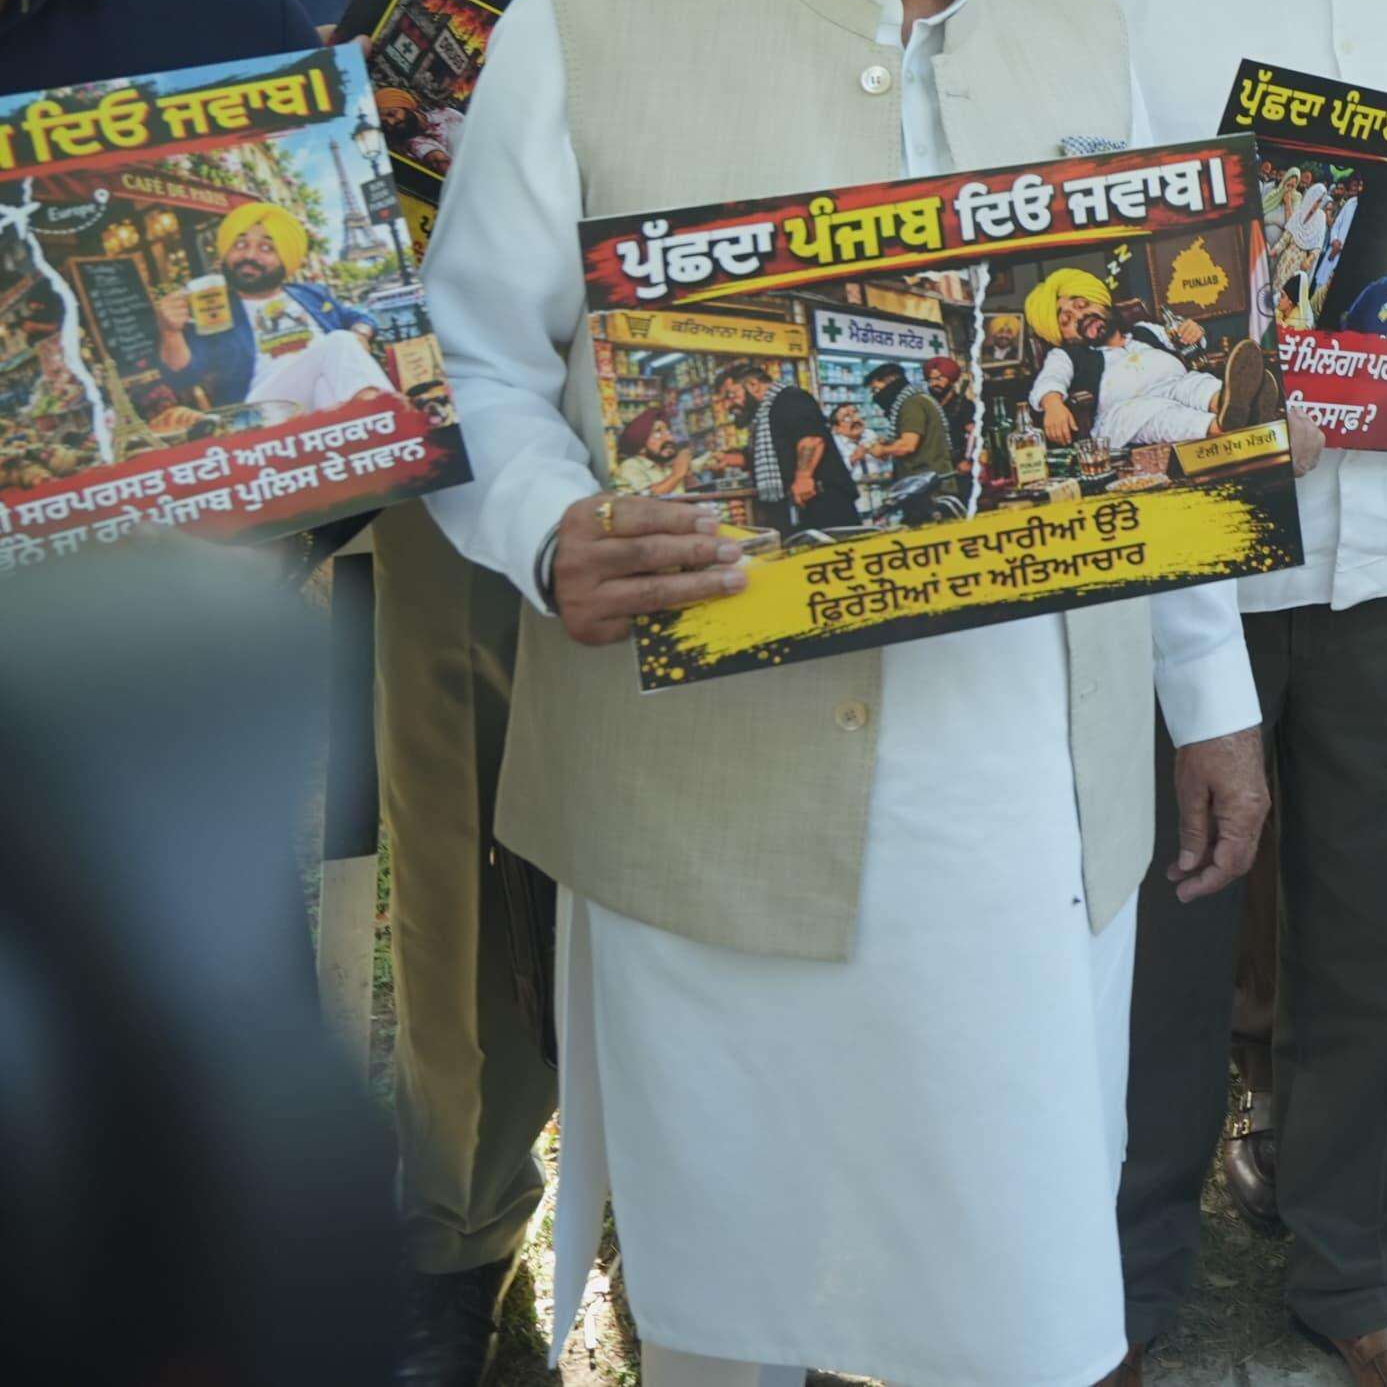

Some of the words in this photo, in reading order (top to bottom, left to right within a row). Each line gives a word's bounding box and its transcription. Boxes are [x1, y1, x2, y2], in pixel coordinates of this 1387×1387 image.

[26, 88, 152, 162] ਦਿਓ
[159, 68, 332, 138] ਜਵਾਬ।
[1236, 70, 1324, 127] ਪੁੱਛਦਾ
[616, 220, 774, 299] ਪੁੱਛਦਾ
[784, 195, 943, 263] ਪੰਜਾਬ
[954, 174, 1053, 242] ਦਿਓ
[1064, 156, 1227, 226] ਜਵਾਬ।
[1182, 275, 1219, 289] PUNJAB
[1279, 334, 1300, 371] ਦੋਂ
[1294, 336, 1368, 377] ਮਿਲੇਗਾ
[14, 470, 166, 525] ਸਰਪਰਸਤ
[168, 446, 231, 485] ਬਣੀ
[233, 437, 297, 465] ਆਪ
[299, 411, 397, 452] ਸਰਕਾਰ
[235, 468, 319, 511] ਪੁਲਿਸ
[320, 452, 348, 481] ਦੇ
[349, 437, 426, 474] ਜਵਾਨ
[804, 548, 854, 585] ਕਦੋਂ
[861, 540, 950, 581] ਰੁਕੇਗਾ
[958, 512, 1085, 560] ਵਪਾਰੀਆਂ
[1095, 502, 1140, 540] ਉੱਤੇ
[948, 572, 981, 597] ਦਾ
[988, 542, 1146, 588] ਅੱਤਿਆਚਾਰ
